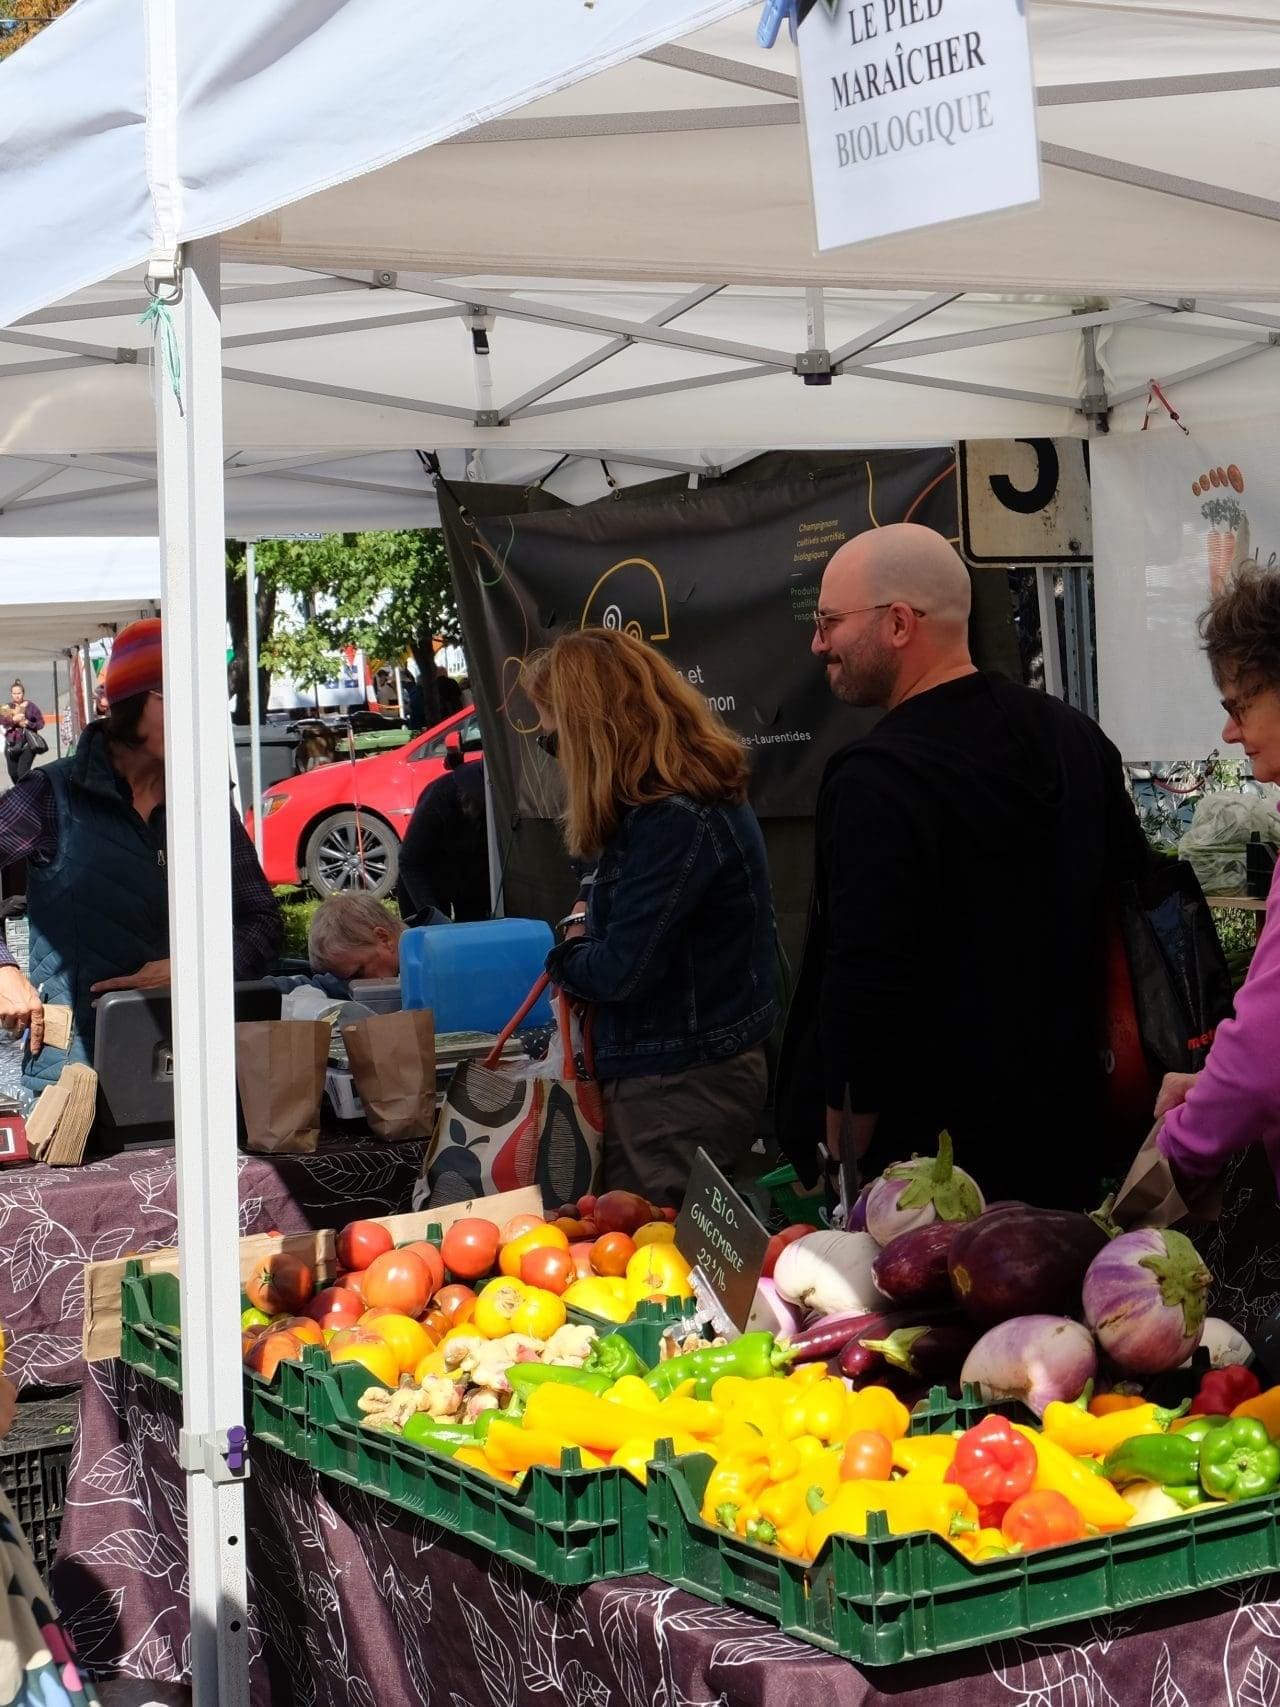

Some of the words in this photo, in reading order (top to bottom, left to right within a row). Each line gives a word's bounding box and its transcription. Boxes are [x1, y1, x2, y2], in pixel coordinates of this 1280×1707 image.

[848, 2, 878, 46] LE
[831, 31, 987, 112] MARAÎCHER
[835, 90, 995, 169] BIOLOGIQUE
[688, 665, 705, 684] et
[736, 731, 812, 746] es-Laurentides
